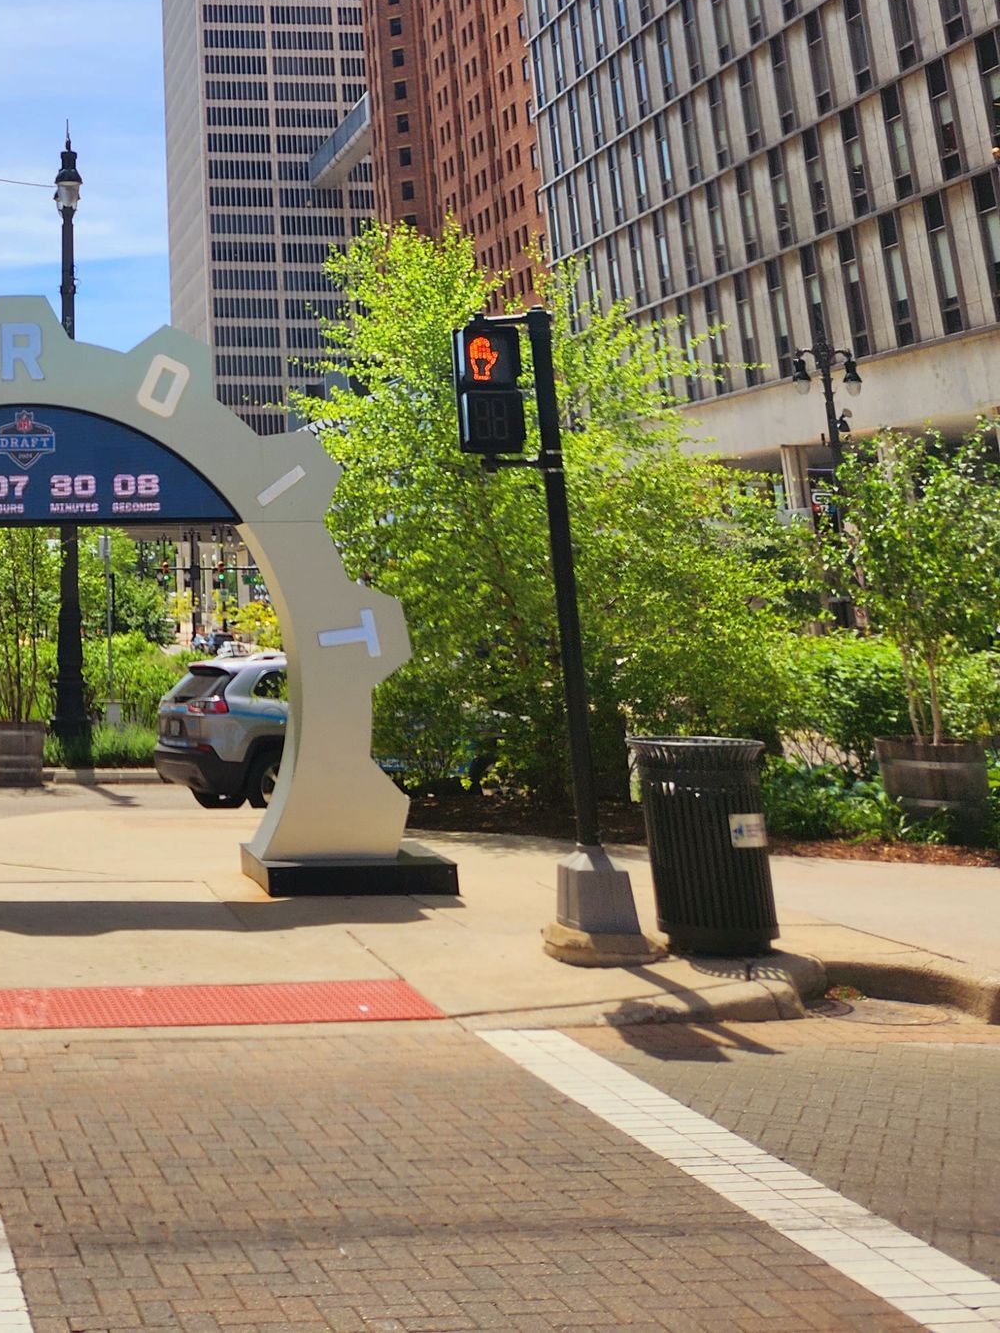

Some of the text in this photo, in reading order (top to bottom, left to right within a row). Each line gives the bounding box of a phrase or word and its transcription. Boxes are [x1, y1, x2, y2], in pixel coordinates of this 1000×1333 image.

[0, 437, 50, 448] DRAFT
[50, 474, 97, 497] 30
[113, 474, 160, 497] 08
[50, 502, 99, 513] MINUTES
[112, 501, 161, 512] SECONDS
